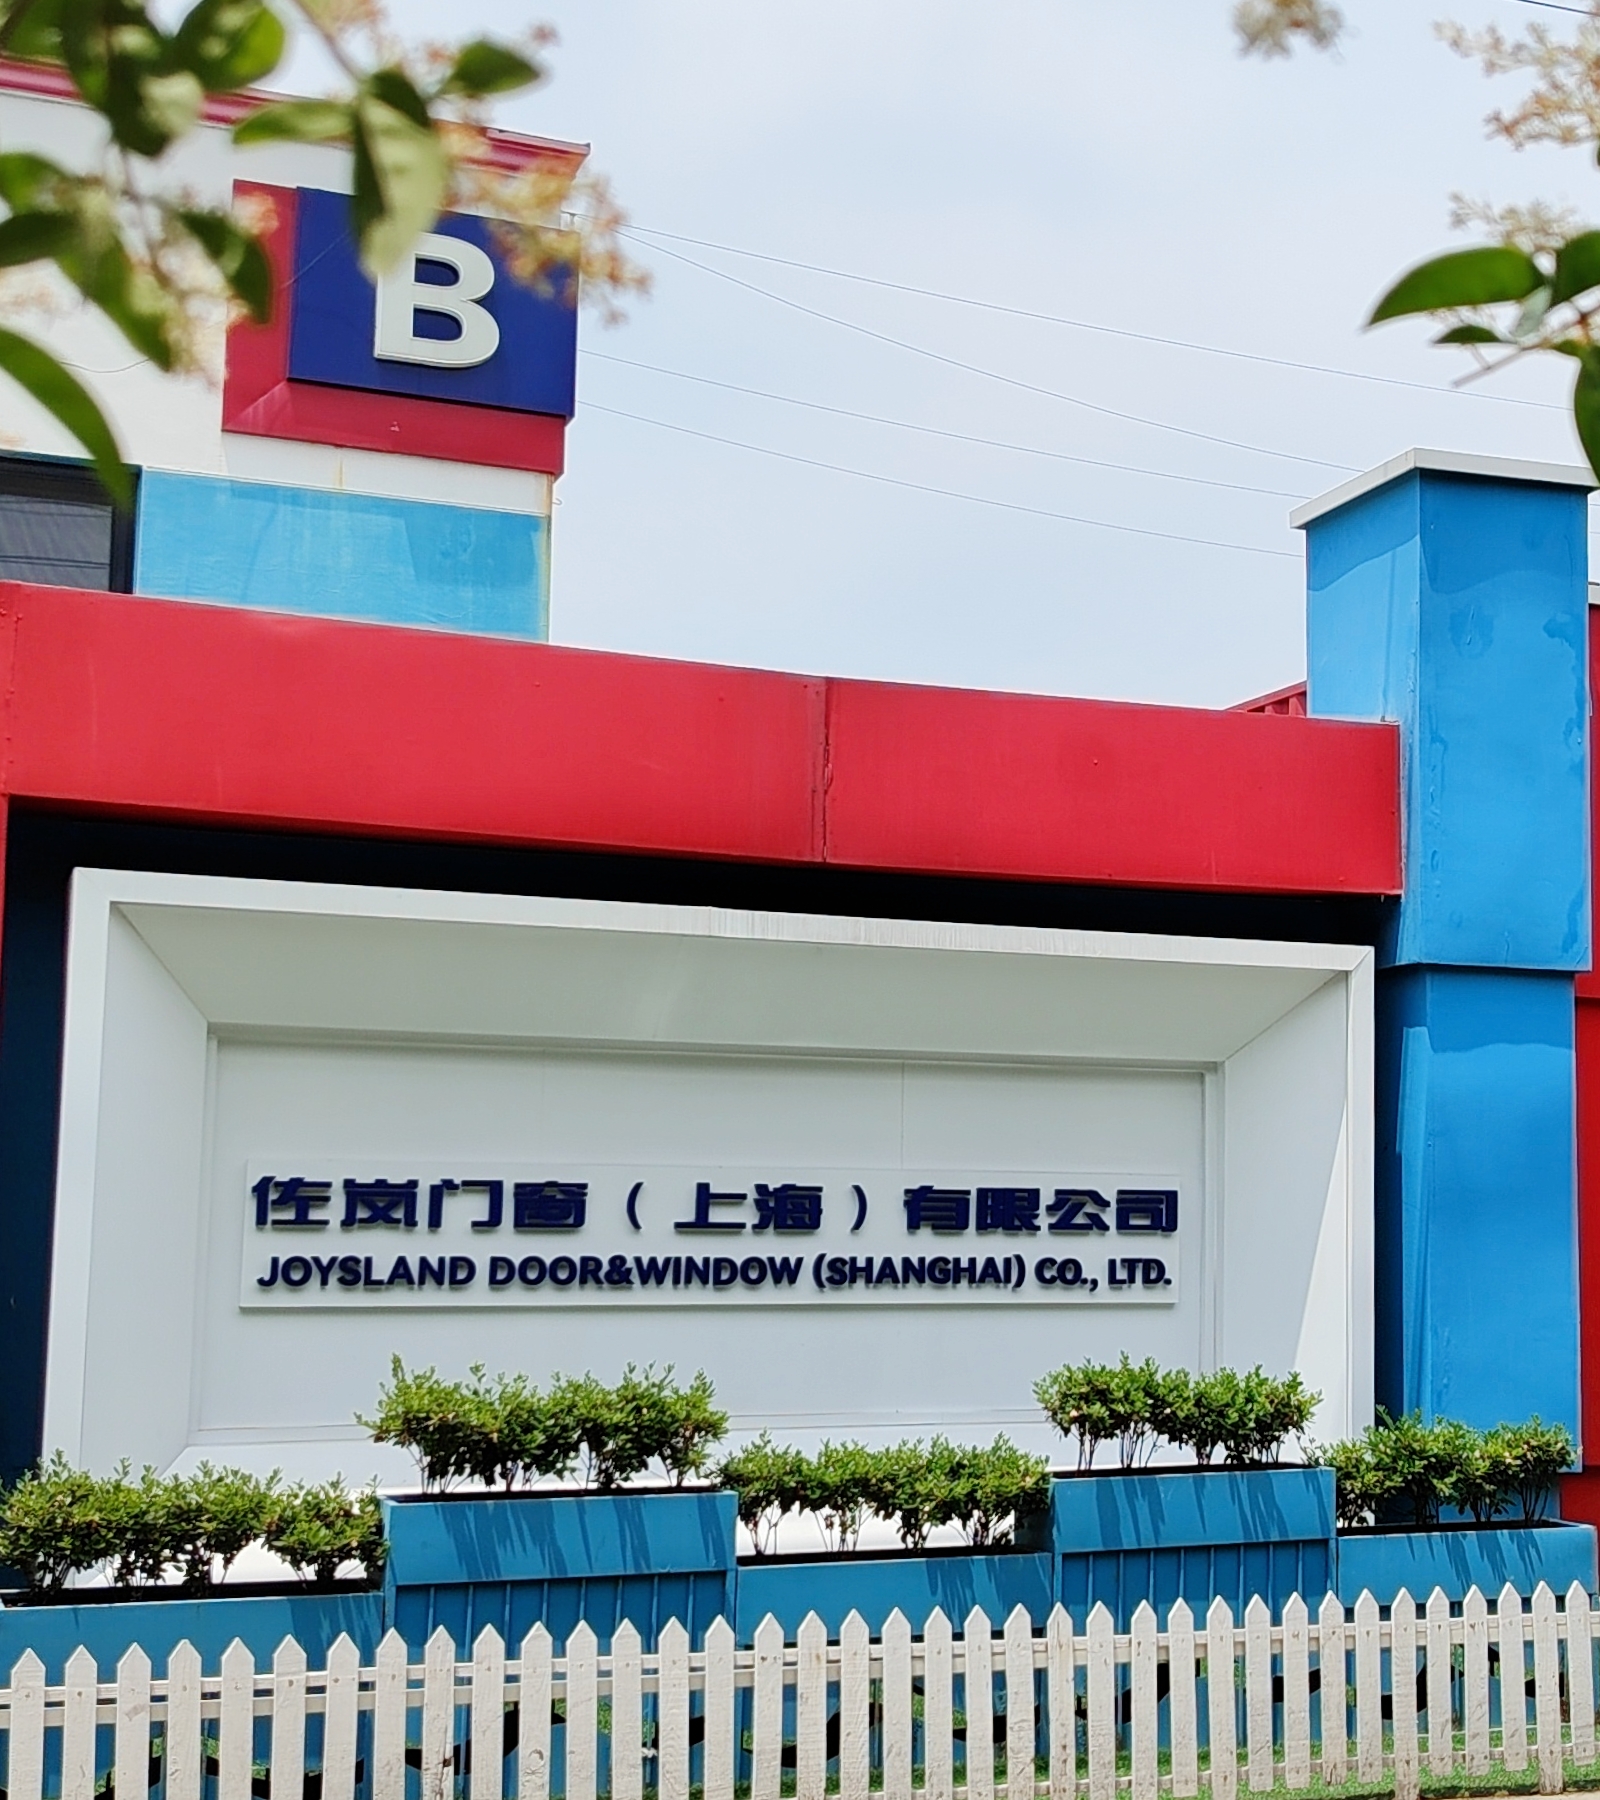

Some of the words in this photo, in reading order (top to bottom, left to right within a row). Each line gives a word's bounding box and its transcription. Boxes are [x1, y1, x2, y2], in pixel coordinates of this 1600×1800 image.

[373, 232, 501, 369] B
[256, 1256, 477, 1289] JOYSLAND
[488, 1254, 804, 1288] DOOR&WINDOW
[812, 1253, 1026, 1289] (SHANGHAI)
[1034, 1257, 1099, 1292] CO.,
[1107, 1258, 1172, 1287] LTD.
